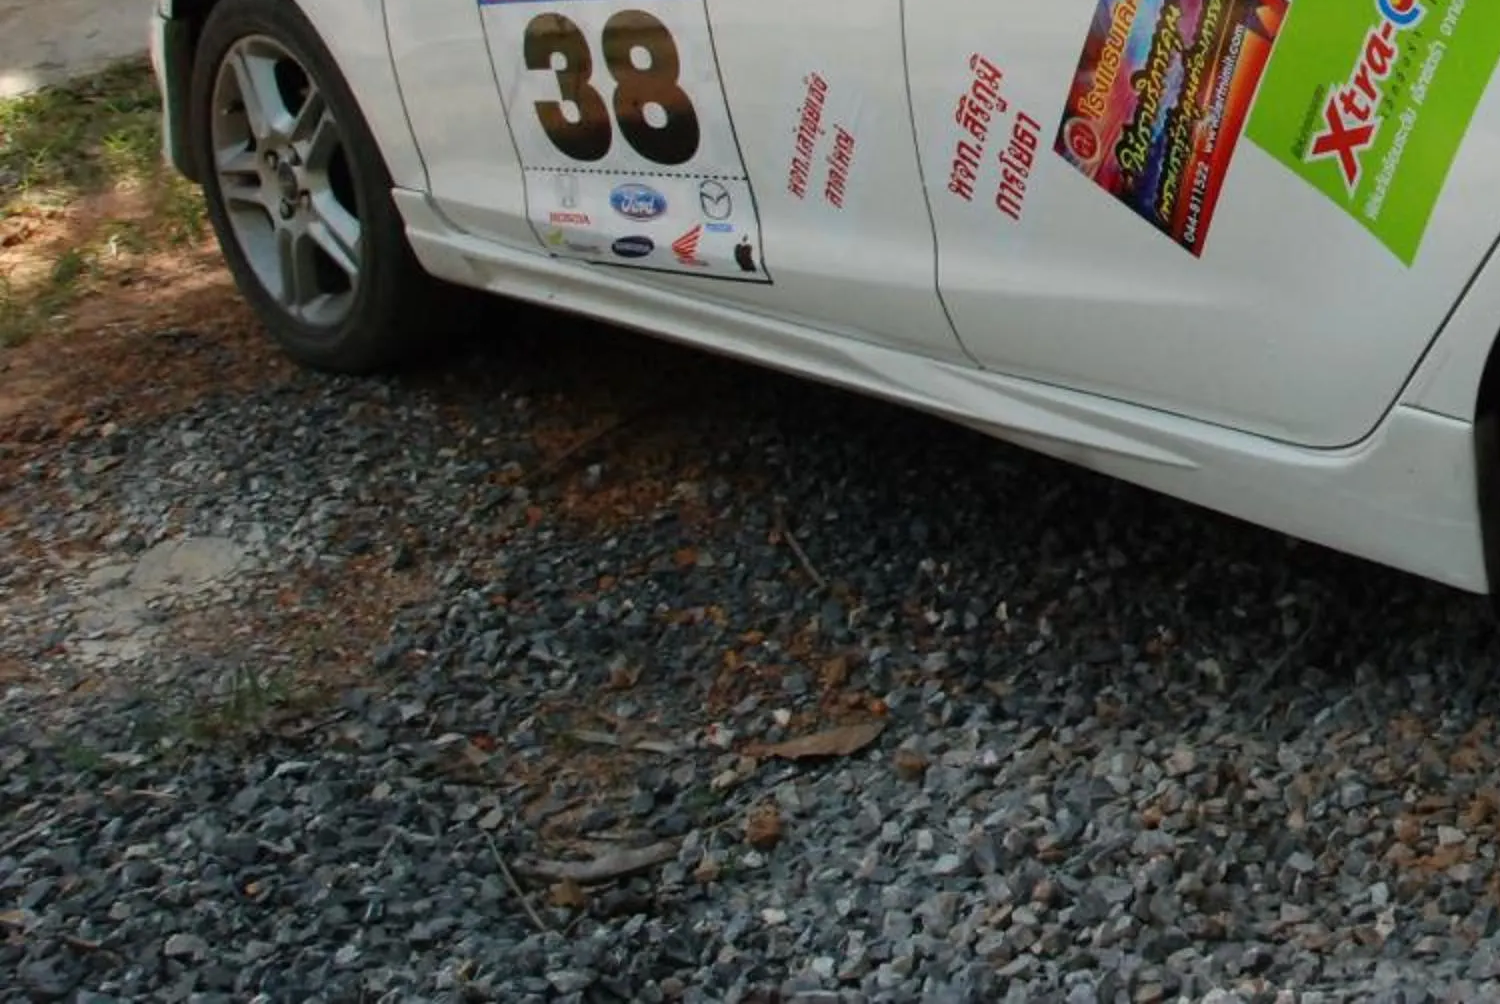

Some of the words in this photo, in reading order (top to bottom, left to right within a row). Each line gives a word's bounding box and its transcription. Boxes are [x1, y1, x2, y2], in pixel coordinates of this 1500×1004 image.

[524, 9, 700, 166] 38
[996, 111, 1042, 221] การโยธา
